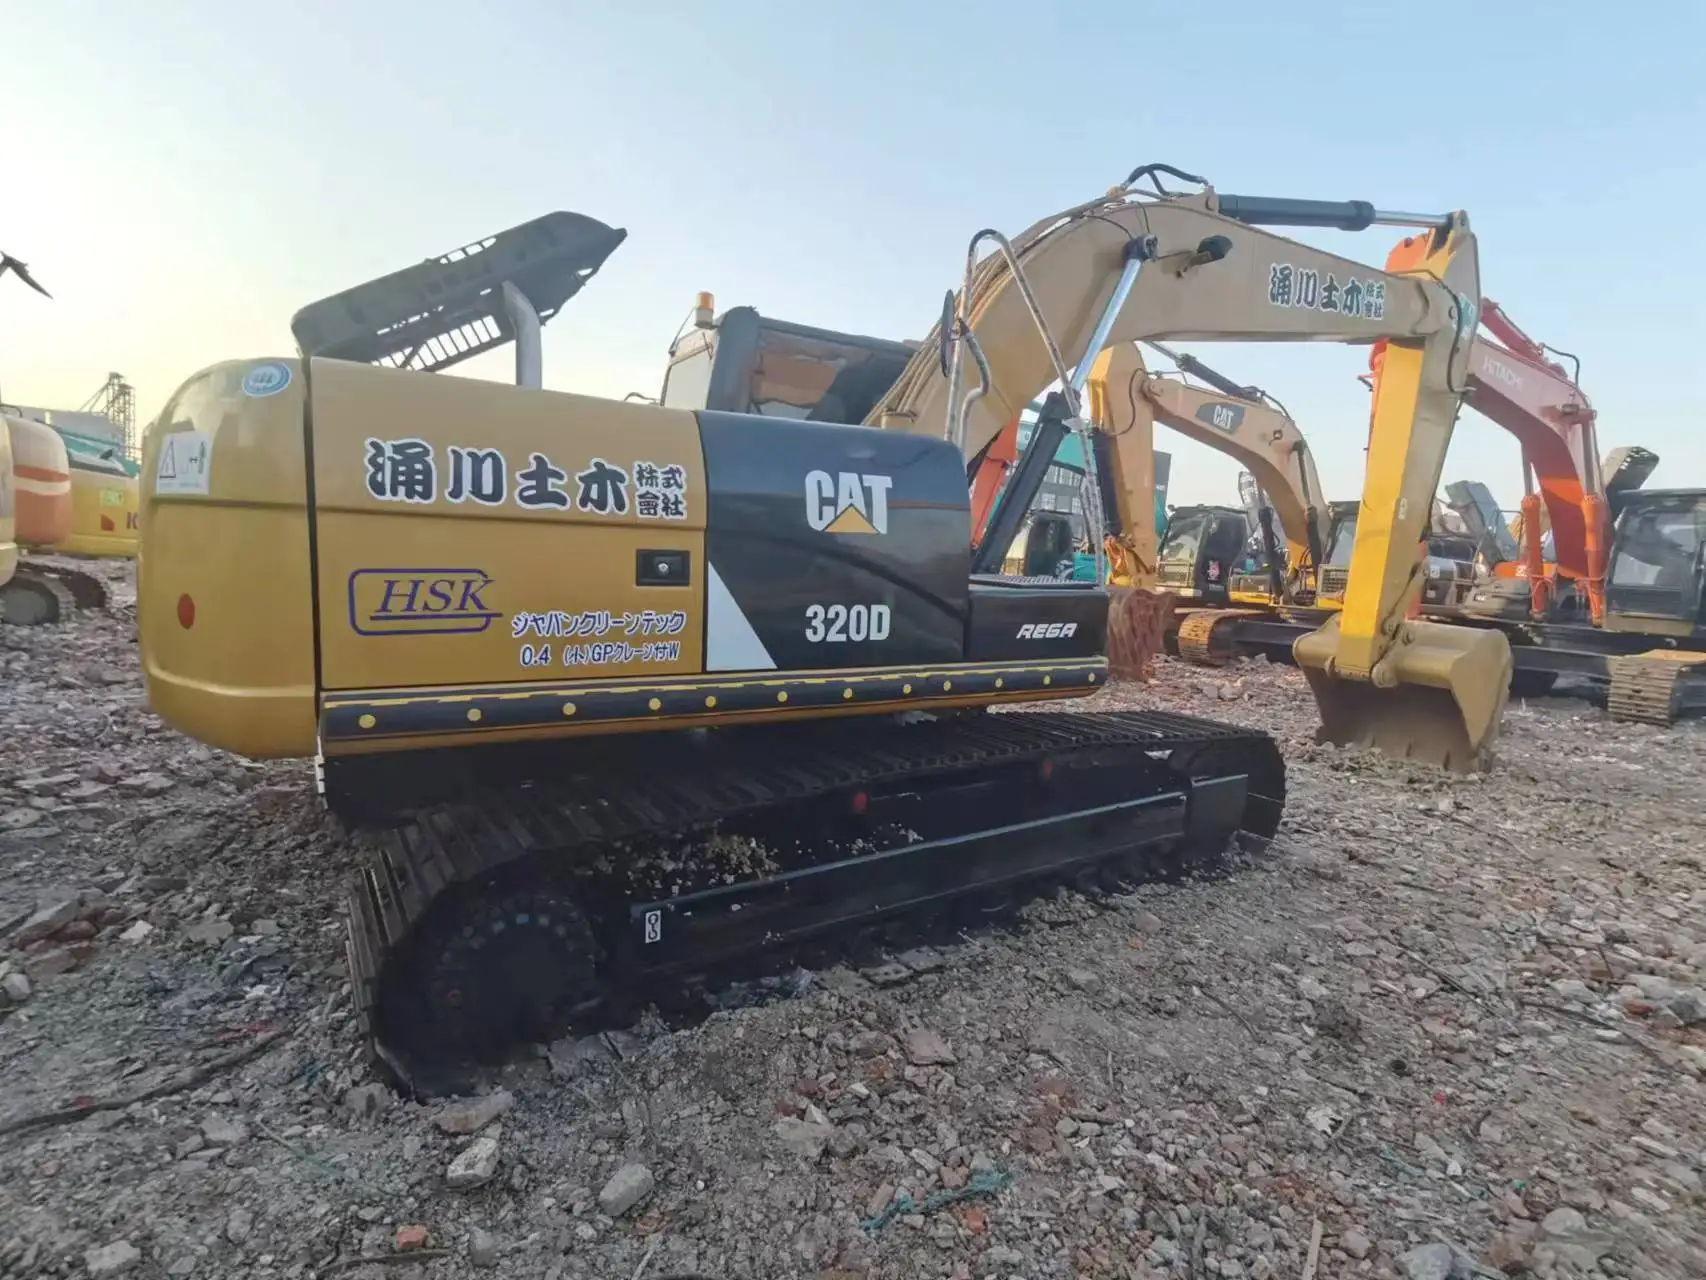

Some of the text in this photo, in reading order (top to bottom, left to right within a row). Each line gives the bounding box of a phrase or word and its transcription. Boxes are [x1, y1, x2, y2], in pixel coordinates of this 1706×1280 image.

[1213, 404, 1234, 430] CAT
[804, 469, 893, 535] CAT
[374, 579, 496, 612] HSK
[804, 604, 891, 642] 320D
[520, 643, 551, 666] 0.4
